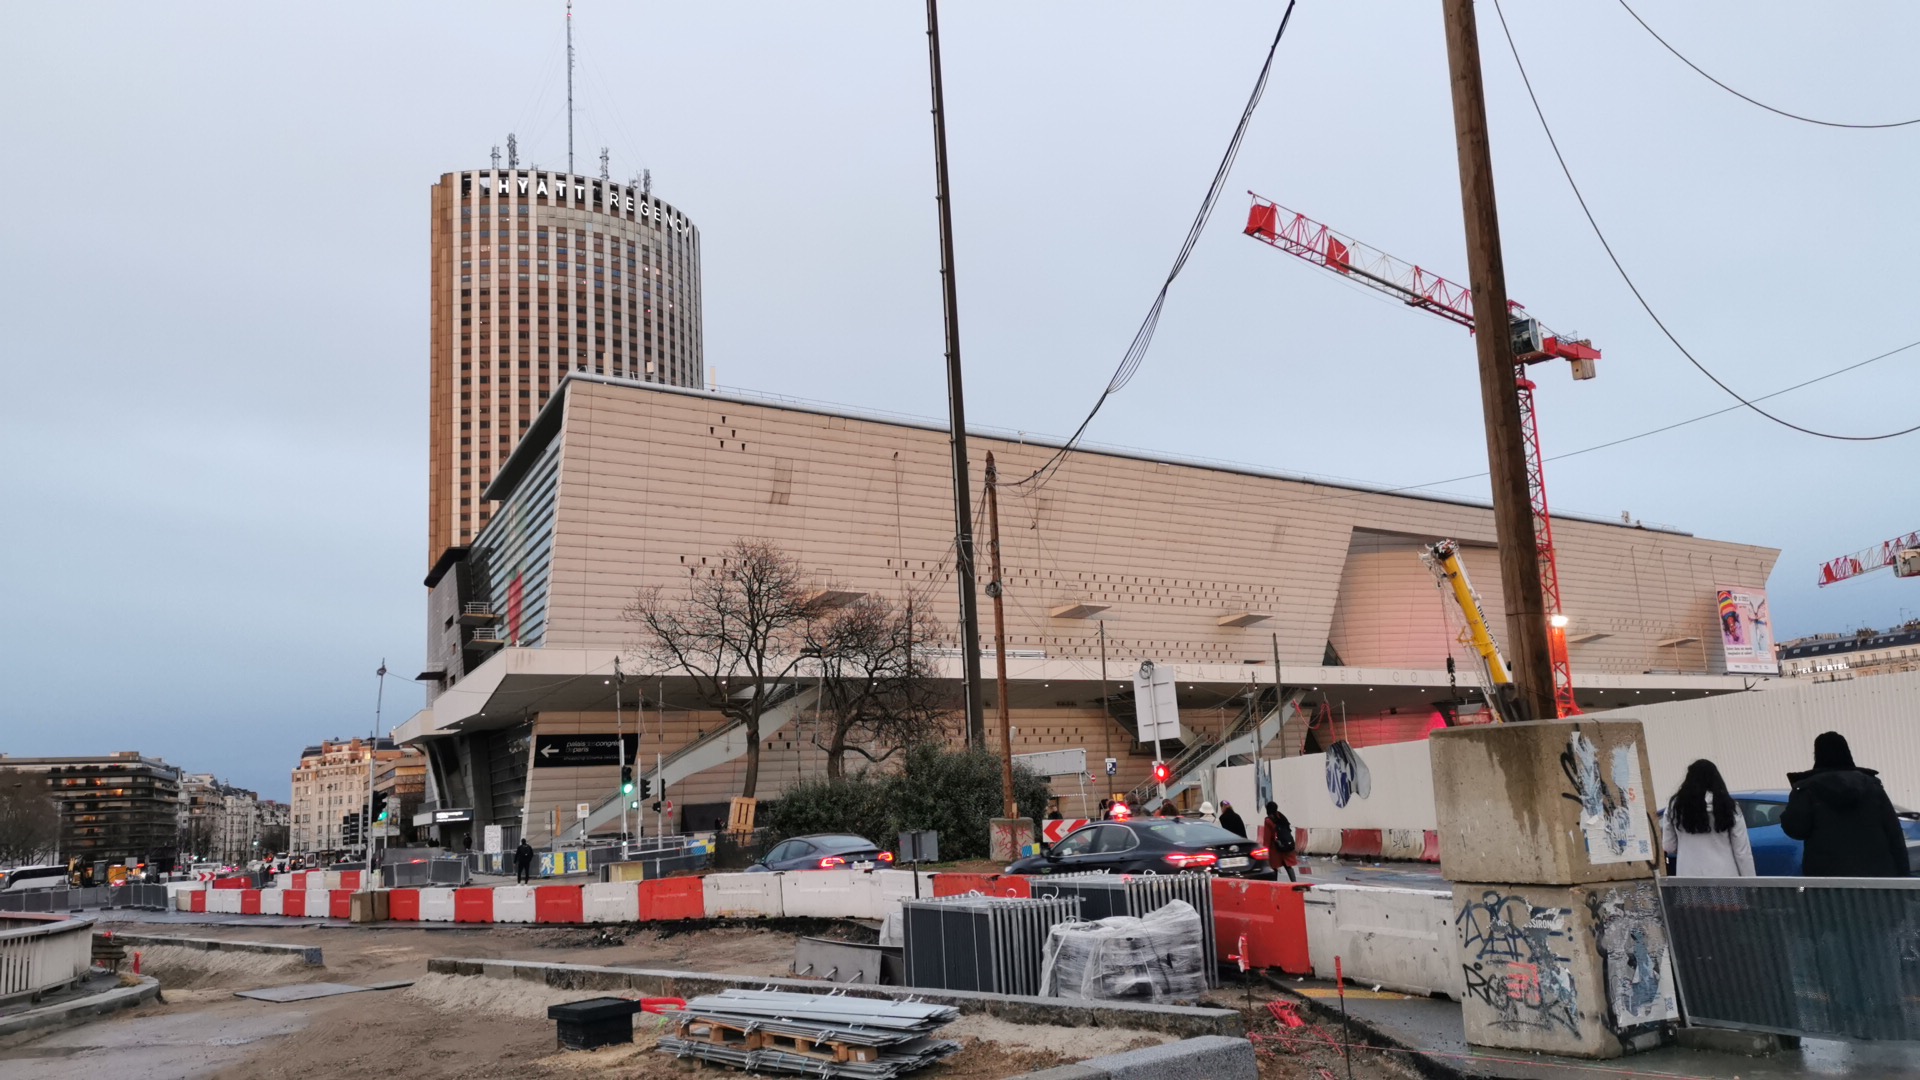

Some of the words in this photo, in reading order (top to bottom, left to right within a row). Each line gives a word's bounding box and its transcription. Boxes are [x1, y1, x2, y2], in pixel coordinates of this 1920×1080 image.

[498, 180, 585, 199] HYATT
[610, 192, 690, 235] REGENCY
[1816, 663, 1850, 673] FERTEL
